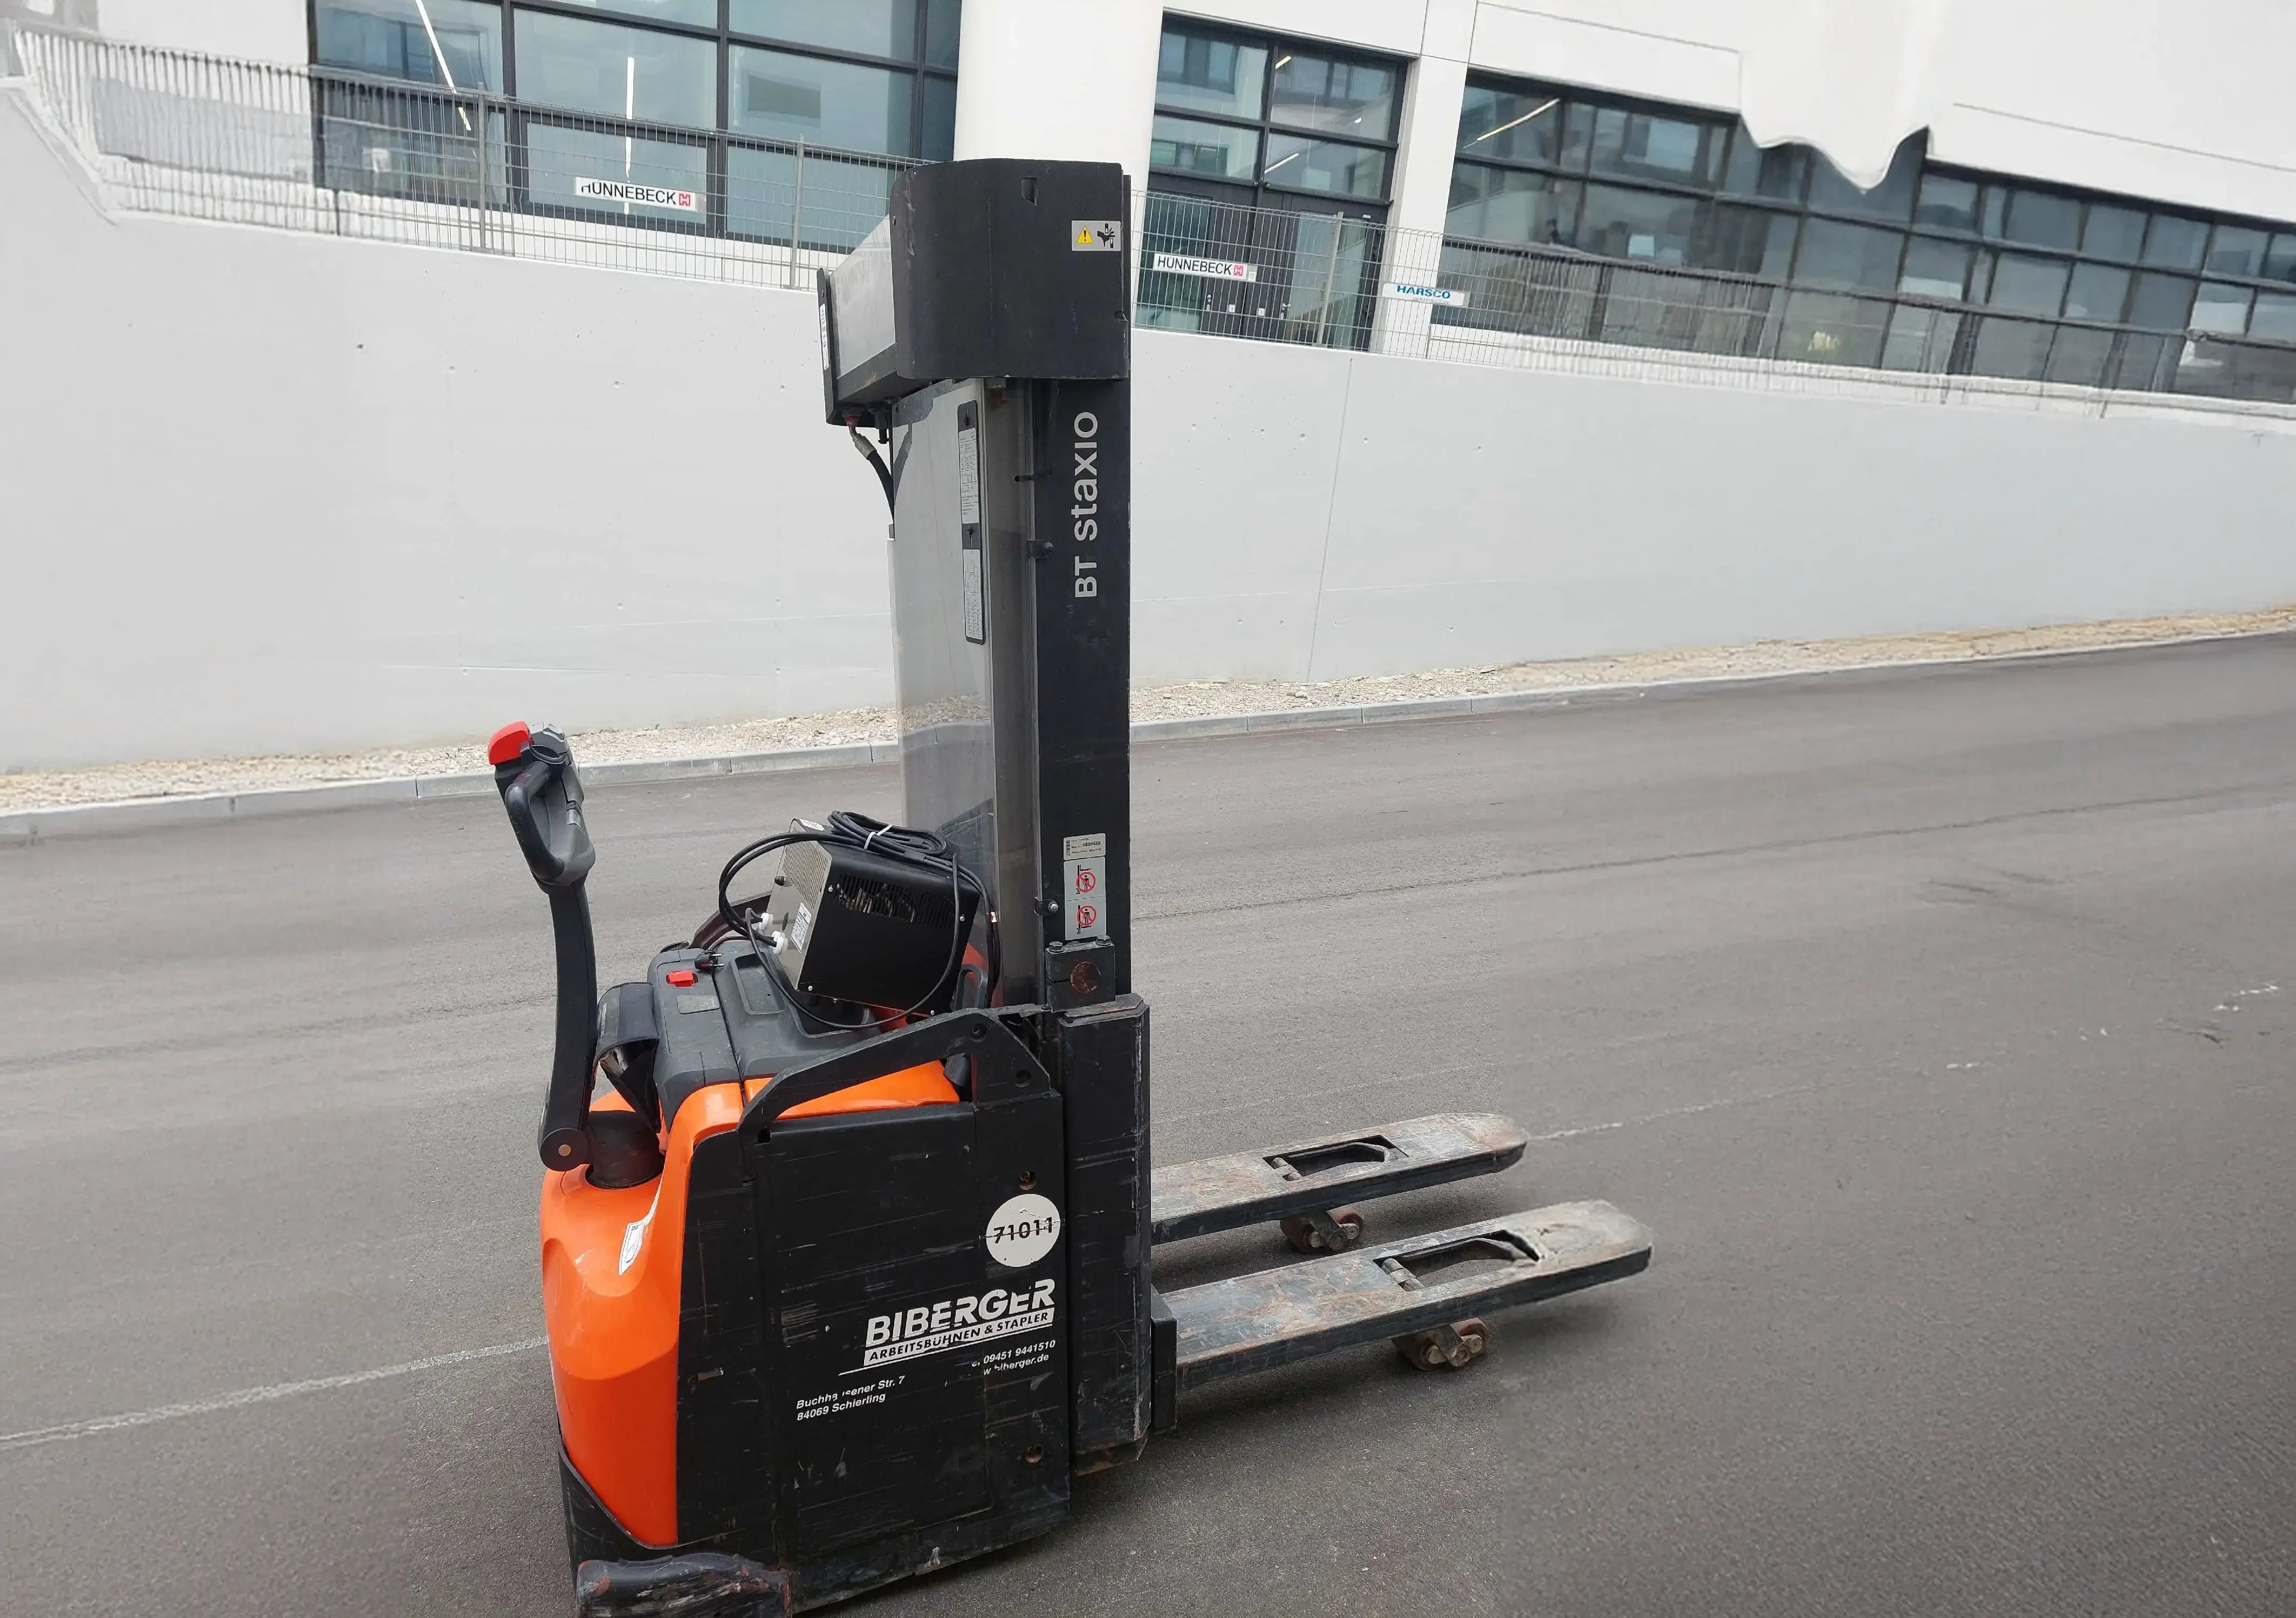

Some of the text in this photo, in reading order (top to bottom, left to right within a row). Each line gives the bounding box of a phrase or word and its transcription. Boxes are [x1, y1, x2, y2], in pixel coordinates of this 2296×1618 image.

[1397, 285, 1451, 299] HARSCO
[1075, 556, 1098, 598] BT
[993, 1217, 1053, 1244] 71011
[866, 1279, 1055, 1347] BIBERGER
[869, 1312, 1048, 1362] ARBEITSBÜHNEN & STAPLER
[983, 1349, 1012, 1364] 09451
[1015, 1339, 1056, 1356] 9441510
[796, 1375, 906, 1409] Buchhasener Str. 7
[797, 1393, 886, 1421] 84069 Schierling
